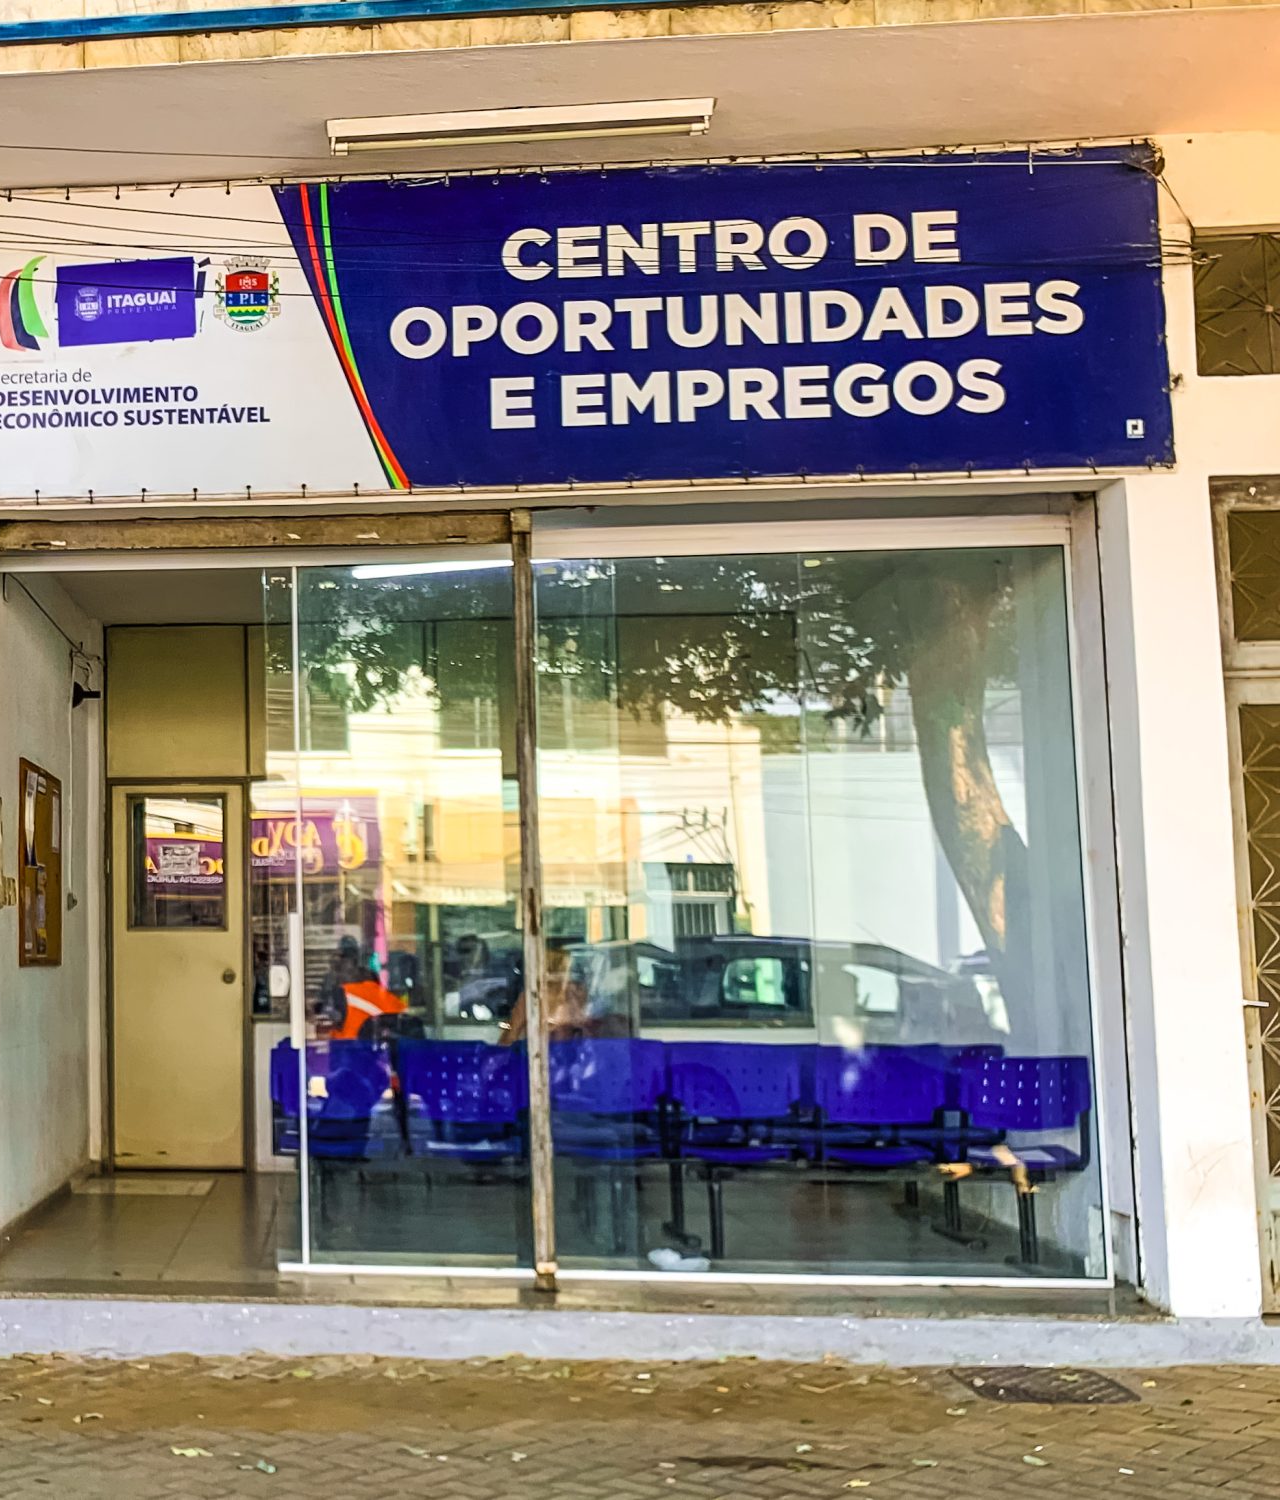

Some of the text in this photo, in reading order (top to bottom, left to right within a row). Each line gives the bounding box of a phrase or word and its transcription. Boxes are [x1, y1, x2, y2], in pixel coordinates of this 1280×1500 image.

[501, 209, 962, 281] CENTRO DE
[106, 286, 177, 308] ITAGUAÍ
[389, 280, 1085, 359] OPORTUNIDADES
[72, 367, 92, 383] de
[490, 358, 1007, 429] E EMPREGOS
[124, 403, 271, 427] SUSTENTÁVEL
